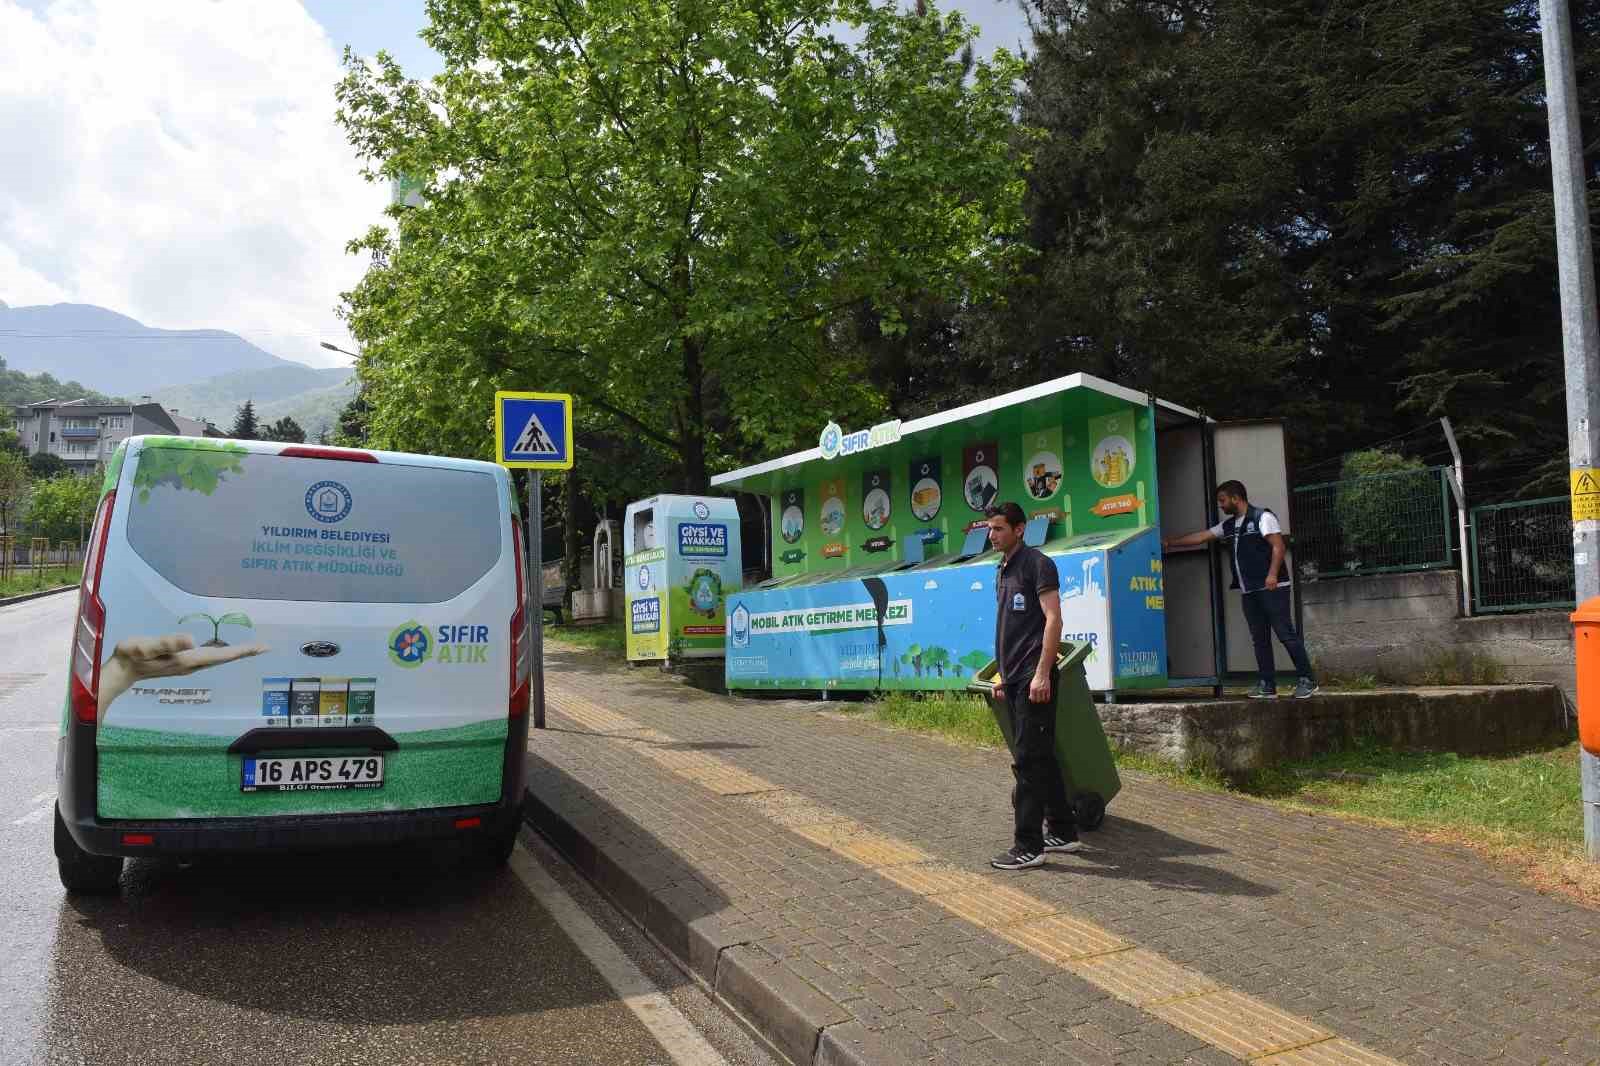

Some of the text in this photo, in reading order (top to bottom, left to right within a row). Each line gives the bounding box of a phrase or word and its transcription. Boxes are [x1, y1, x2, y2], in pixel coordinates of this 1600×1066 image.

[842, 432, 869, 452] SIFIR
[262, 526, 318, 539] YILDIRIM
[682, 525, 724, 538] GİYSİ VE
[682, 537, 725, 546] AYAKKABI
[380, 550, 398, 561] VE
[241, 558, 277, 571] SIFIR
[281, 559, 317, 573] ATIK
[1129, 575, 1158, 592] ATIK
[751, 615, 780, 630] MOBİL
[781, 614, 804, 627] ATIK
[806, 610, 853, 626] GETİRME
[438, 625, 489, 643] SIFIR
[437, 645, 489, 664] ATIK
[131, 687, 211, 696] TRANSIT
[259, 758, 379, 783] 16 APS 479
